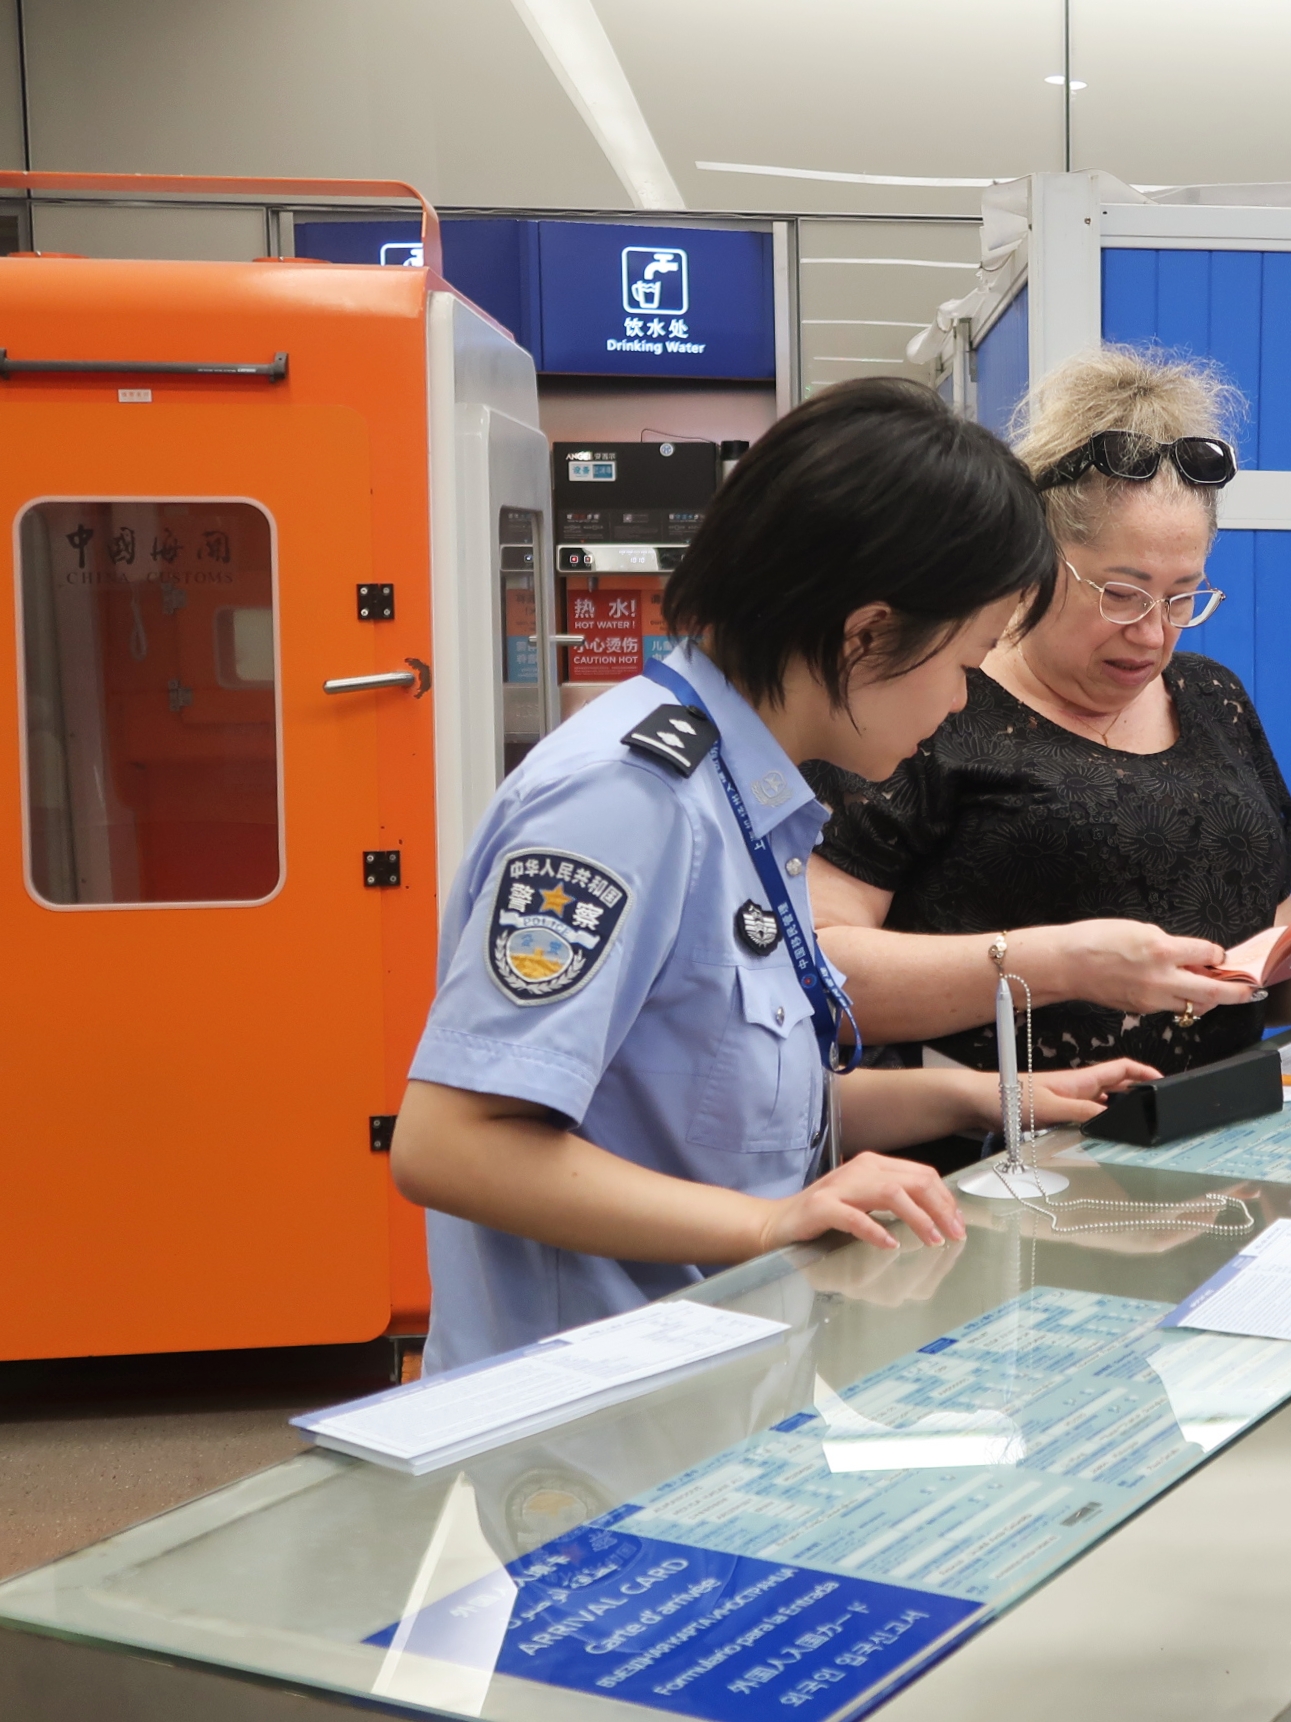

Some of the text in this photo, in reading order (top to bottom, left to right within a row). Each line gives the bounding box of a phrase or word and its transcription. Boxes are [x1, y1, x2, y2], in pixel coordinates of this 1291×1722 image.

[624, 317, 689, 338] 饮水处
[607, 339, 706, 355] Drinking Water
[147, 571, 234, 584] CUSTOMS
[574, 621, 594, 629] HOT
[596, 621, 630, 629] WATER
[574, 656, 638, 664] CAUTION HOT
[510, 858, 623, 909] 中华人民共和国
[523, 917, 572, 938] POLICE
[518, 1558, 689, 1656] ARRIVAL CARD
[666, 1617, 716, 1649] КАРТА
[709, 1566, 798, 1622] ИНОСТРАНЦА
[586, 1622, 646, 1654] Carte
[654, 1644, 741, 1696] Formulario
[736, 1621, 773, 1648] para
[778, 1580, 840, 1617] Entrada
[727, 1600, 869, 1695] 外国人入国カード
[780, 1610, 930, 1708] 외국인 입국신고서
